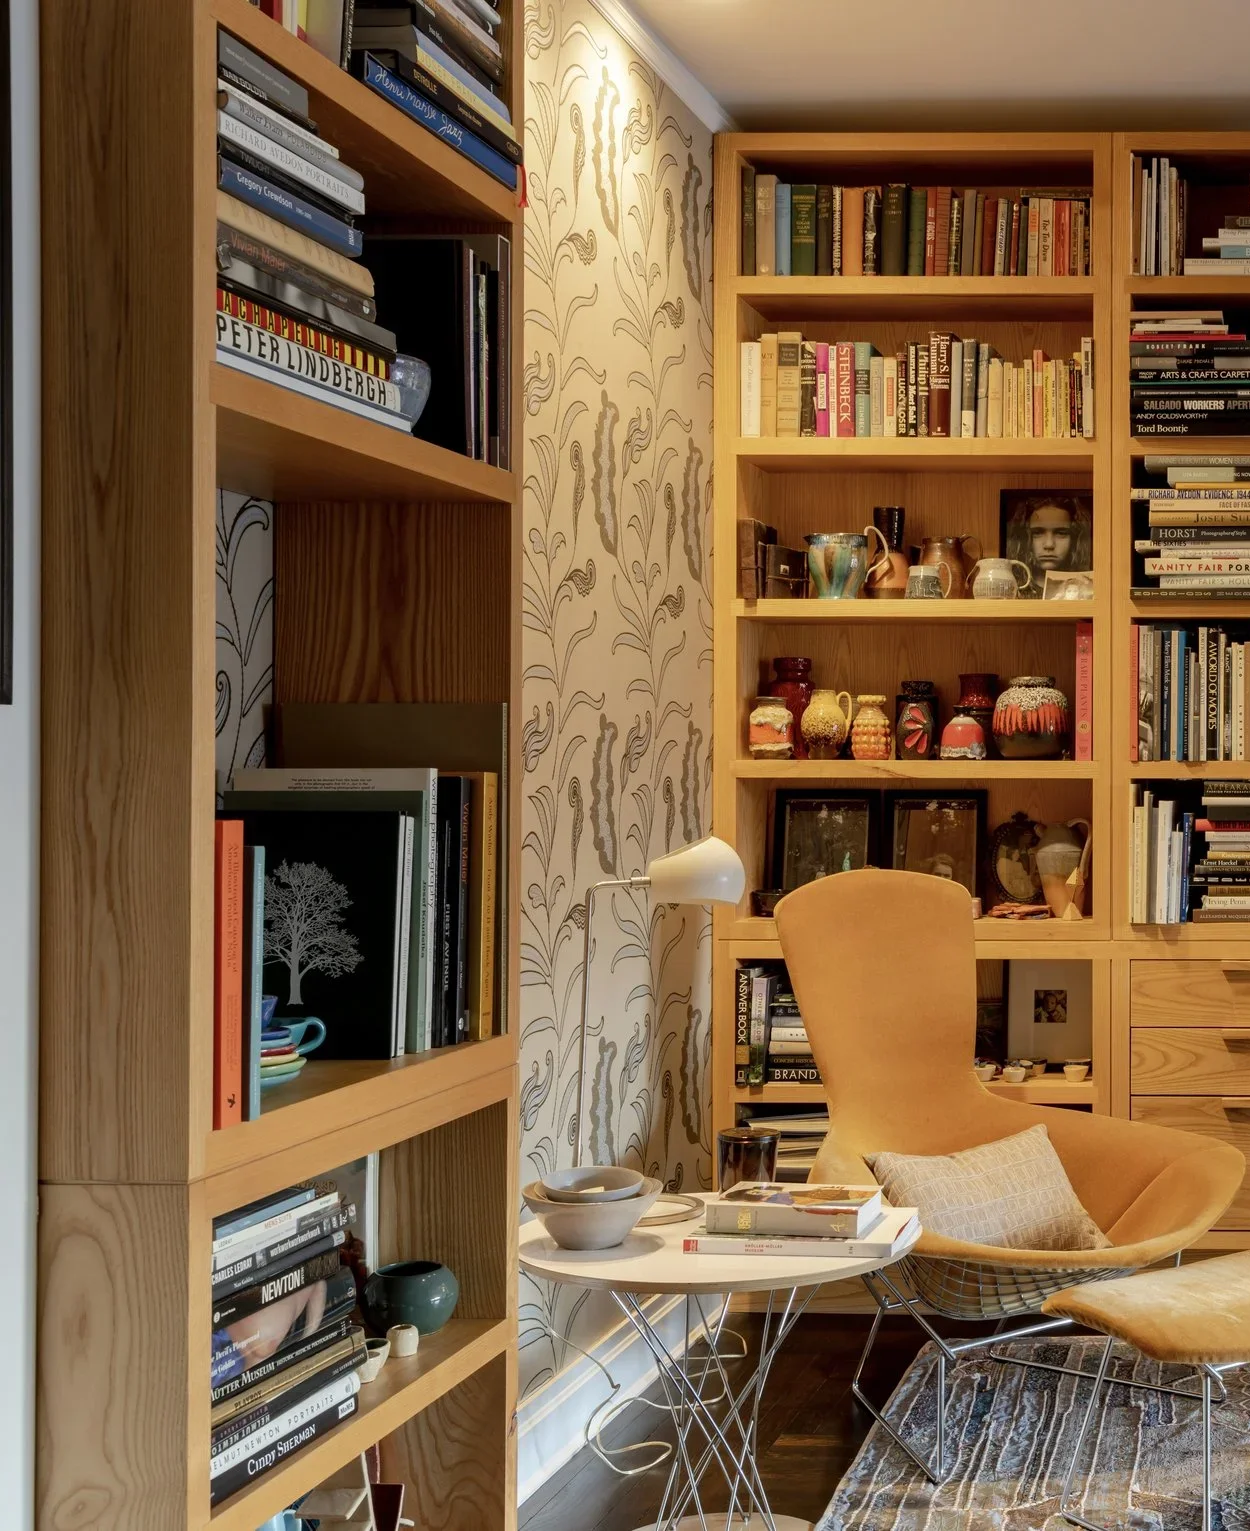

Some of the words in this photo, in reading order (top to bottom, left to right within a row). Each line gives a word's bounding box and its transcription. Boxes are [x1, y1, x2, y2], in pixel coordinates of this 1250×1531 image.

[225, 119, 267, 151] RICHARD
[269, 146, 303, 173] AVEDON
[306, 166, 350, 199] PORTRAITS
[287, 133, 327, 163] POLAROIDS
[237, 171, 262, 195] Gregory
[264, 186, 293, 210] Crewdson
[833, 212, 841, 240] NORMAN
[926, 221, 935, 241] FOCUS
[1042, 219, 1050, 229] The
[231, 231, 259, 258] Vivian
[261, 246, 287, 272] Maier
[832, 242, 841, 268] MAILER
[224, 290, 339, 359] ACHAPELLE
[217, 315, 279, 364] PETER
[287, 342, 386, 406] LINDBERGH
[930, 335, 941, 374] Truman
[939, 335, 950, 363] Harry
[918, 351, 929, 384] Philip
[939, 365, 950, 374] S.
[1160, 371, 1179, 379] ARTS
[1181, 371, 1187, 379] &
[1188, 371, 1218, 379] CRAFTS
[839, 347, 851, 422] STEINBECK
[898, 378, 906, 406] LUCKY
[908, 385, 916, 405] Mort
[1144, 400, 1181, 410] SALGADO
[1183, 400, 1225, 410] WORKERS
[898, 407, 906, 434] LOSER
[1136, 424, 1155, 432] Tord
[1157, 424, 1188, 433] Boontje
[1209, 457, 1233, 465] WOMEN
[1148, 490, 1175, 499] RICHARD
[1177, 490, 1200, 499] AVEDON
[1204, 490, 1233, 499] EVIDENCE
[1159, 528, 1197, 538] HORST
[1151, 563, 1193, 571] VANITY
[1208, 641, 1217, 649] A
[1080, 657, 1088, 678] RARE
[1208, 649, 1217, 682] WORLD
[1080, 684, 1088, 718] PLANTS
[1208, 683, 1217, 695] OF
[1208, 696, 1217, 730] MOVIES
[461, 802, 469, 845] Vivian
[428, 821, 437, 909] photography
[460, 848, 468, 884] Maier
[738, 973, 747, 1013] ANSWER
[737, 1014, 746, 1043] BOOK
[774, 1070, 817, 1080] BRAND
[212, 1268, 233, 1285] CHARLES
[235, 1257, 252, 1274] LEDRAY
[261, 1269, 300, 1304] NEWTON
[234, 1390, 263, 1411] PLAYBOY
[211, 1431, 239, 1456] NEWTO
[213, 1450, 241, 1470] ELMUT
[245, 1426, 280, 1451] NEWTON
[288, 1395, 334, 1427] PORTRAITS
